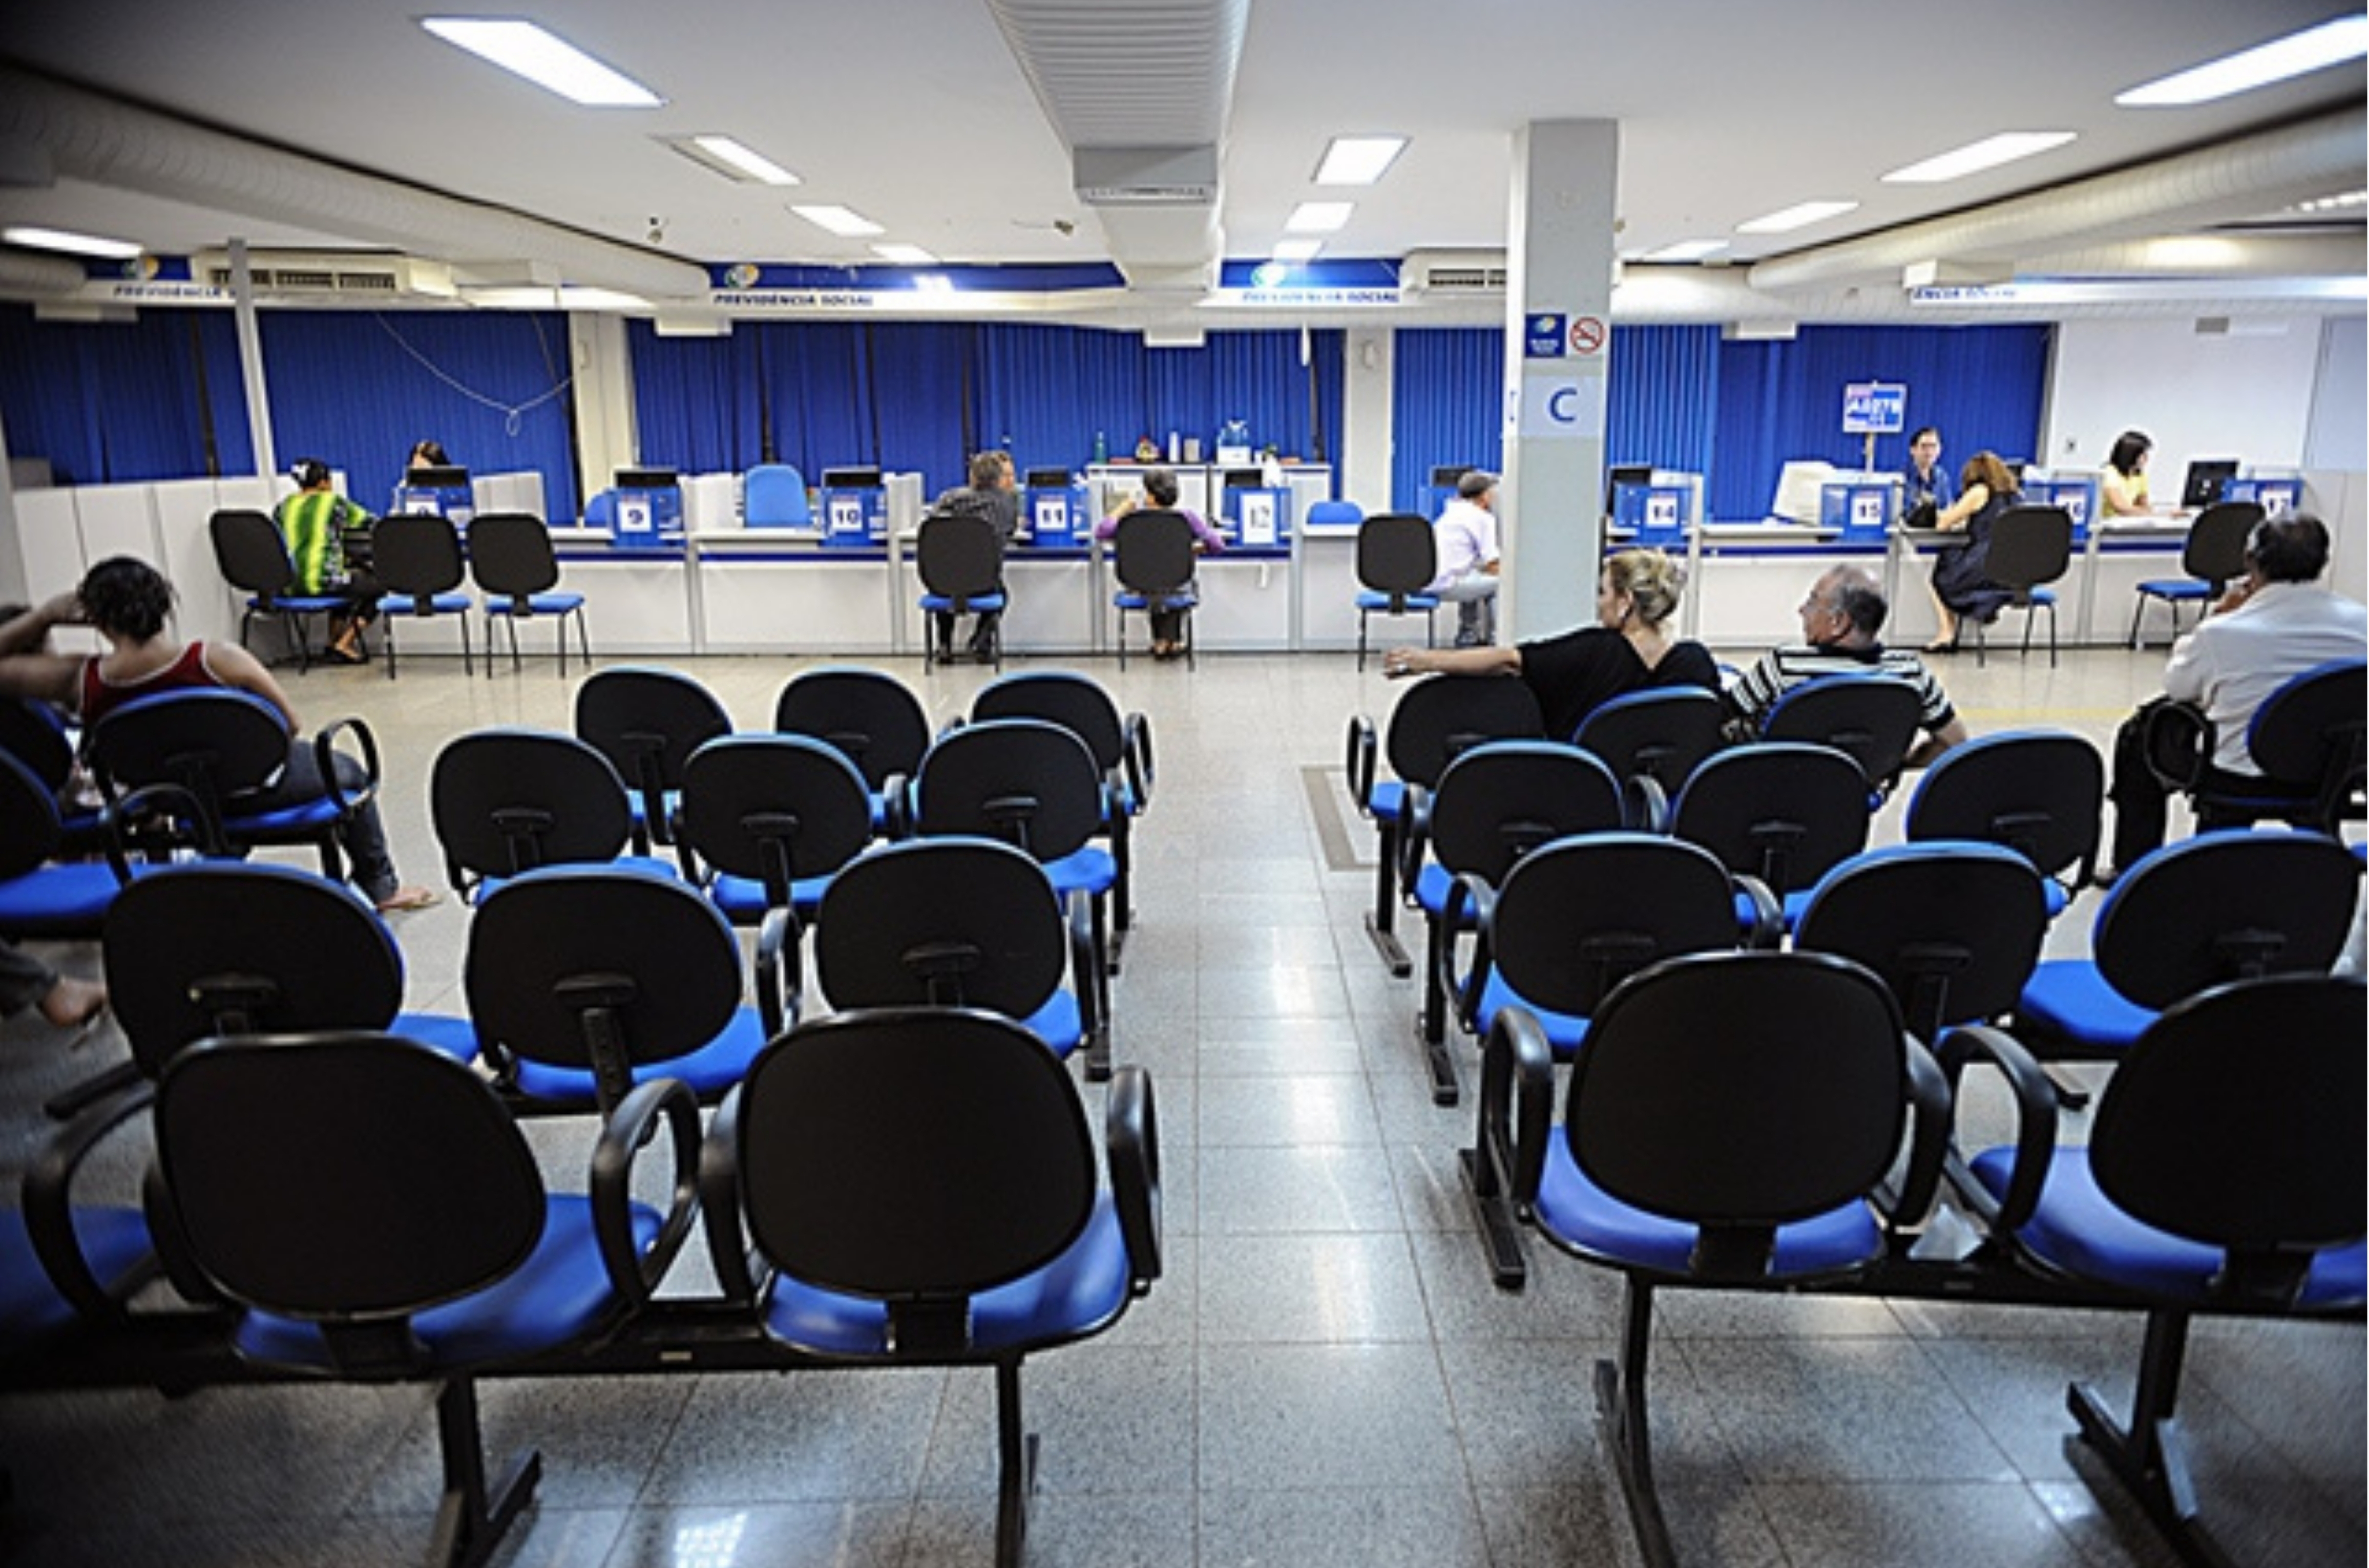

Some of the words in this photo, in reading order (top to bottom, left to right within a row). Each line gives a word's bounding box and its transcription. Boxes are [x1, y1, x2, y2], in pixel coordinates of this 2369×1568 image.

[714, 292, 815, 305] PREVIDÊNCIA
[821, 294, 872, 305] SOCIAL
[1347, 291, 1399, 303] SOCIAL
[1549, 387, 1578, 423] C
[627, 510, 644, 524] 9
[836, 510, 861, 524] 10
[1043, 509, 1063, 523] 11
[1654, 504, 1675, 519] 14
